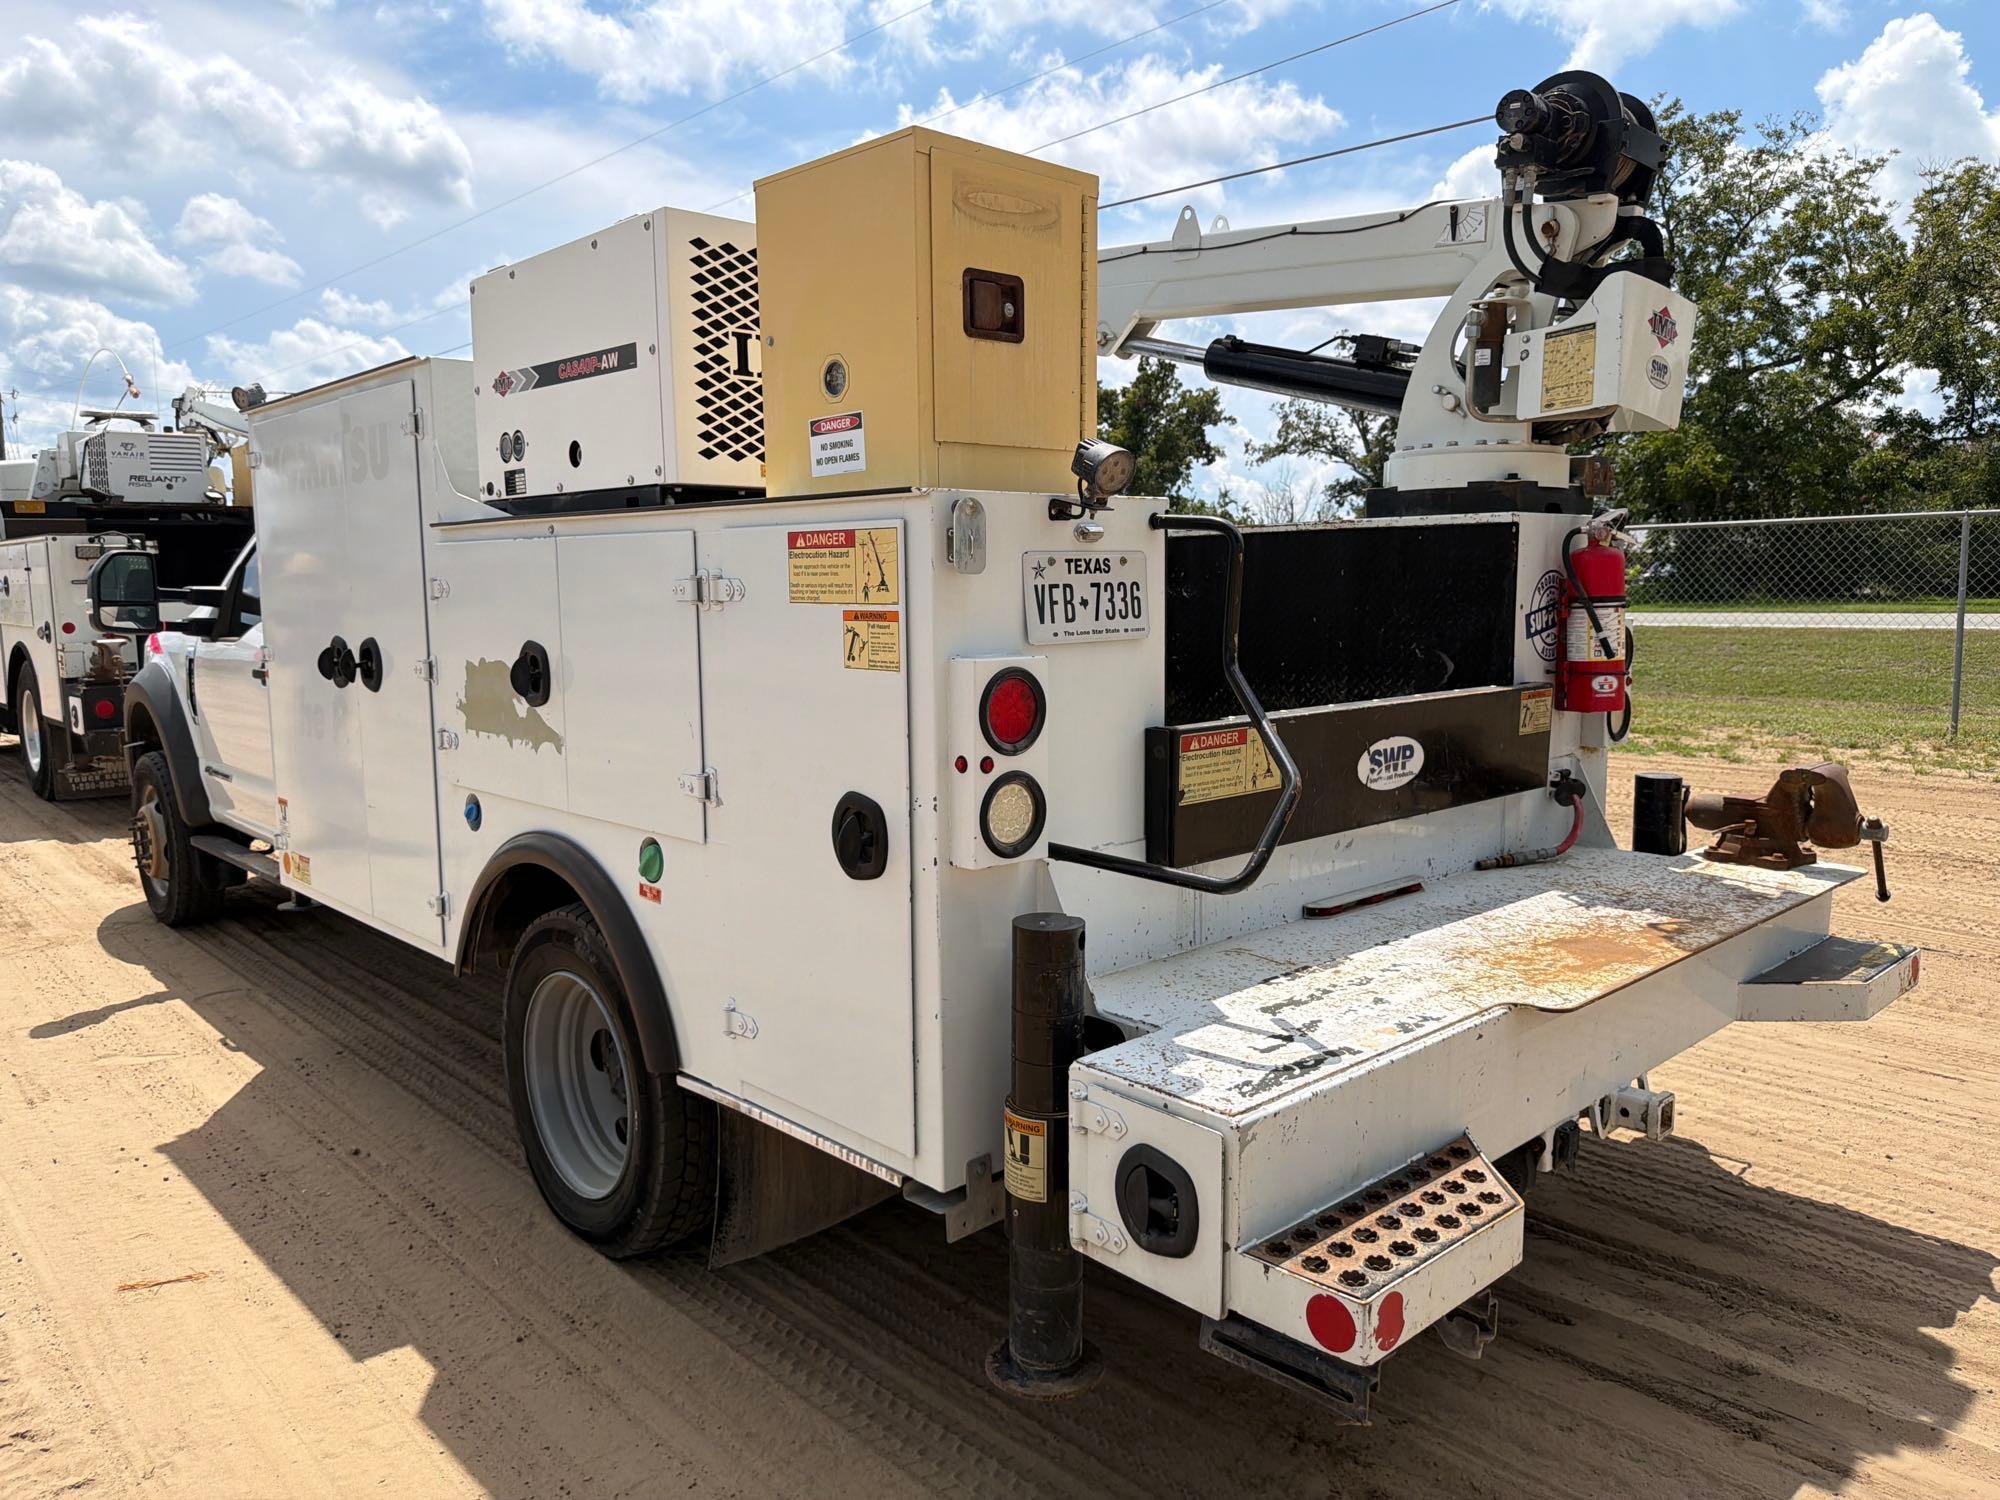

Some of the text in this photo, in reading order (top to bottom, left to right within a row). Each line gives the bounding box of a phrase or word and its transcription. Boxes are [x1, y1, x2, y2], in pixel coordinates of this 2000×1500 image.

[1652, 359, 1668, 377] SWP
[820, 418, 851, 431] DANGER
[820, 439, 853, 451] NO SMOKING
[816, 452, 860, 466] NO OPEN FLAMES
[129, 474, 181, 483] RELIANT
[806, 532, 846, 546] DANGER
[789, 550, 850, 559] Electrocution Hazard
[1064, 557, 1111, 575] TEXAS
[1034, 581, 1142, 624] VFB 7336
[859, 612, 888, 620] WARNING
[1200, 731, 1239, 748] DANGER
[1182, 747, 1241, 762] Electrocution Hazard
[1369, 744, 1415, 775] SWP
